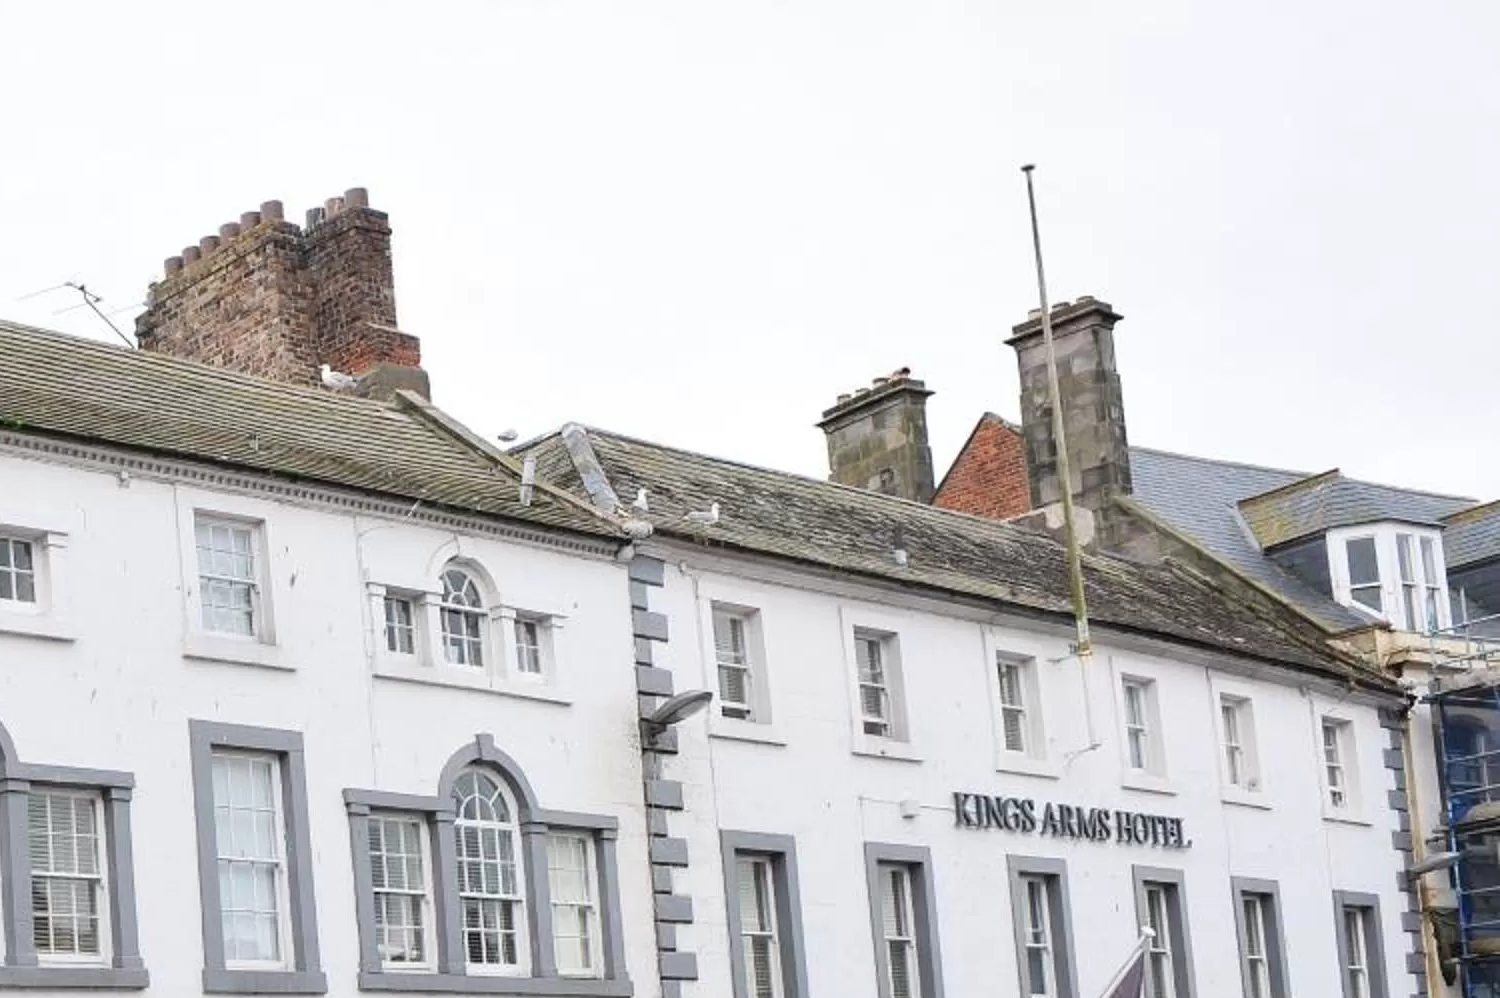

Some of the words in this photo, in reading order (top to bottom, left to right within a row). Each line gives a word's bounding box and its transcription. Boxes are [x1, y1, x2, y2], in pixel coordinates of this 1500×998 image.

[953, 791, 1037, 833] KINGS
[1040, 801, 1112, 843] ARMS
[1114, 808, 1193, 849] HOTEL
